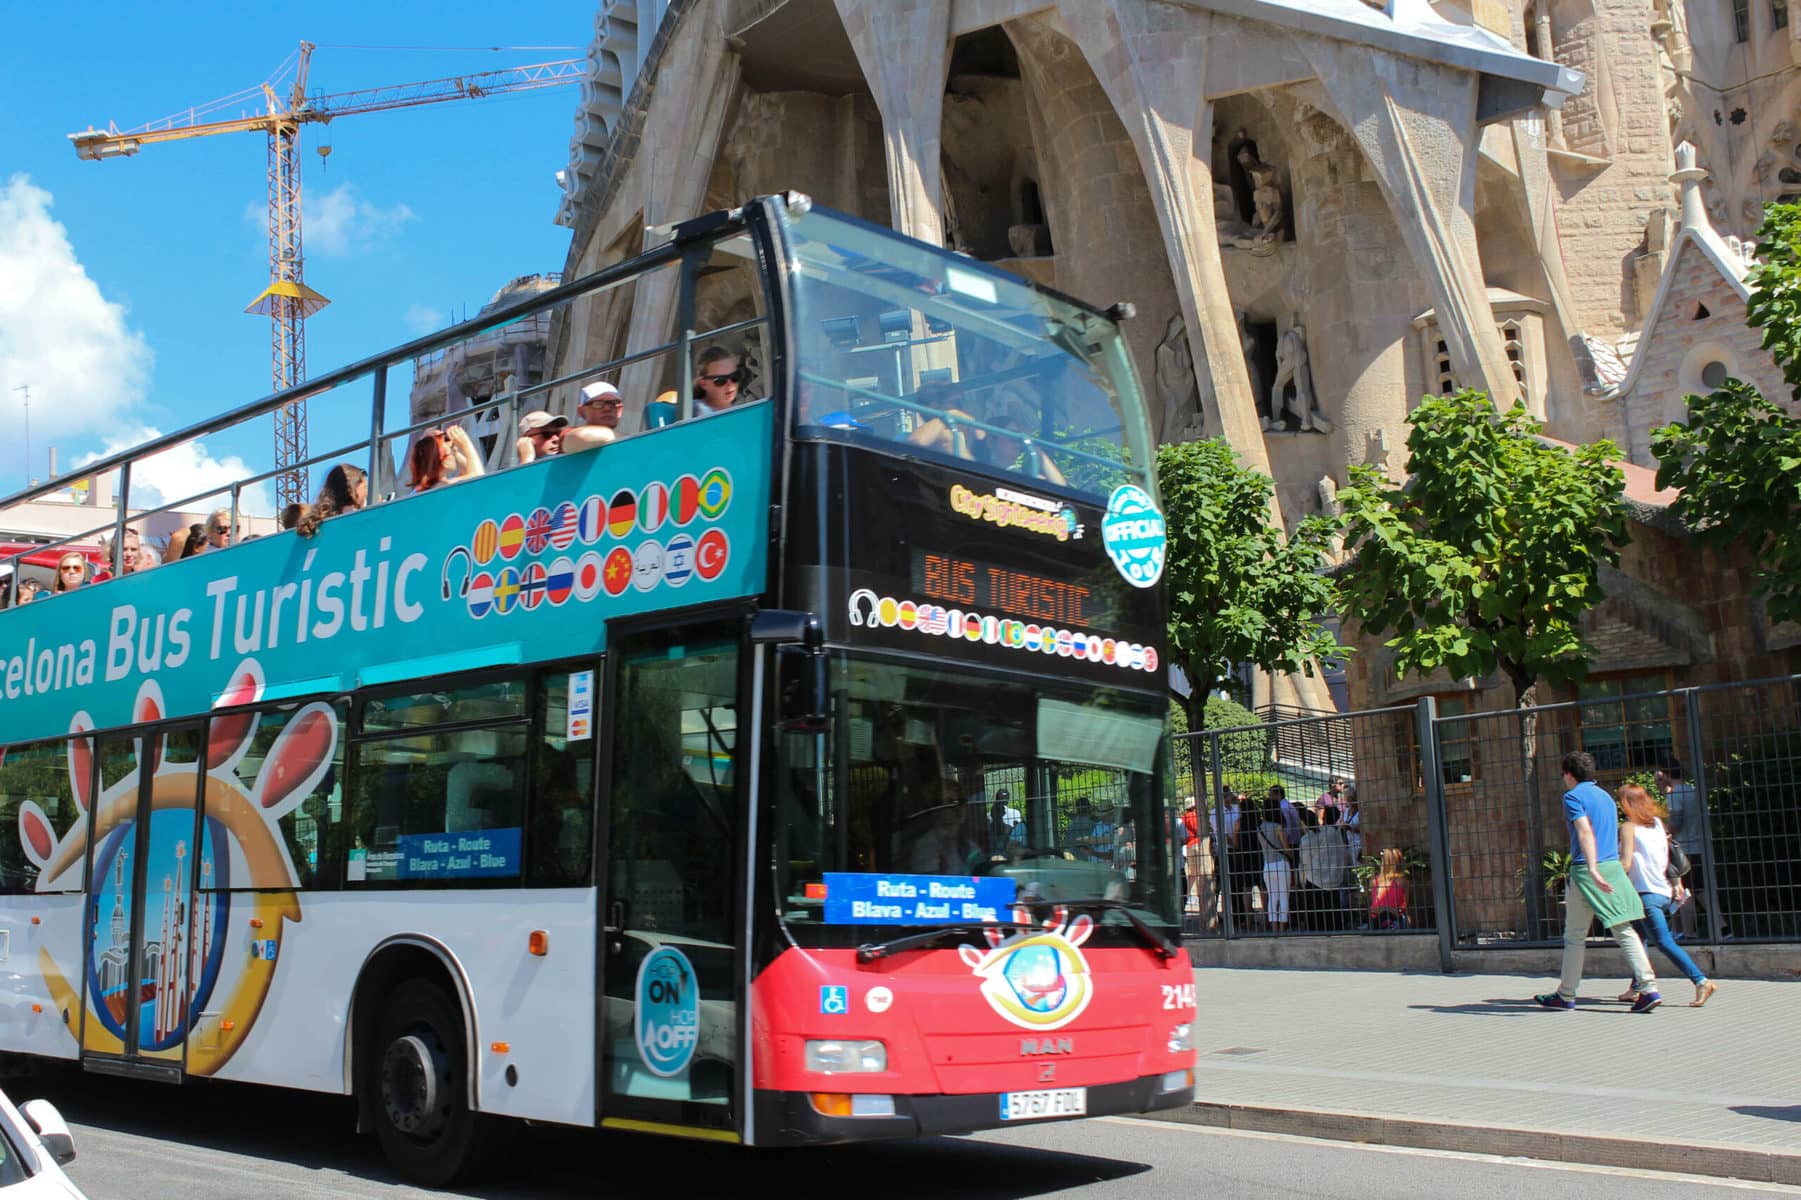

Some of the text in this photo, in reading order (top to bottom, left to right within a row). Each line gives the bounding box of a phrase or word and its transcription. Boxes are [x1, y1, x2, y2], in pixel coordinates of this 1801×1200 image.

[925, 554, 1090, 627] BUS TURISTIC
[105, 604, 193, 683] Bus
[207, 535, 429, 660] Turístic
[423, 838, 449, 854] Ruta
[458, 836, 491, 852] Route
[479, 852, 506, 868] Blue
[876, 880, 917, 898] Ruta
[928, 881, 976, 899] Route
[852, 901, 901, 918] Blava
[915, 901, 950, 919] Azul
[962, 902, 998, 919] Blue
[648, 979, 680, 1005] ON
[657, 1023, 697, 1049] OFF
[1021, 1039, 1073, 1055] MAN
